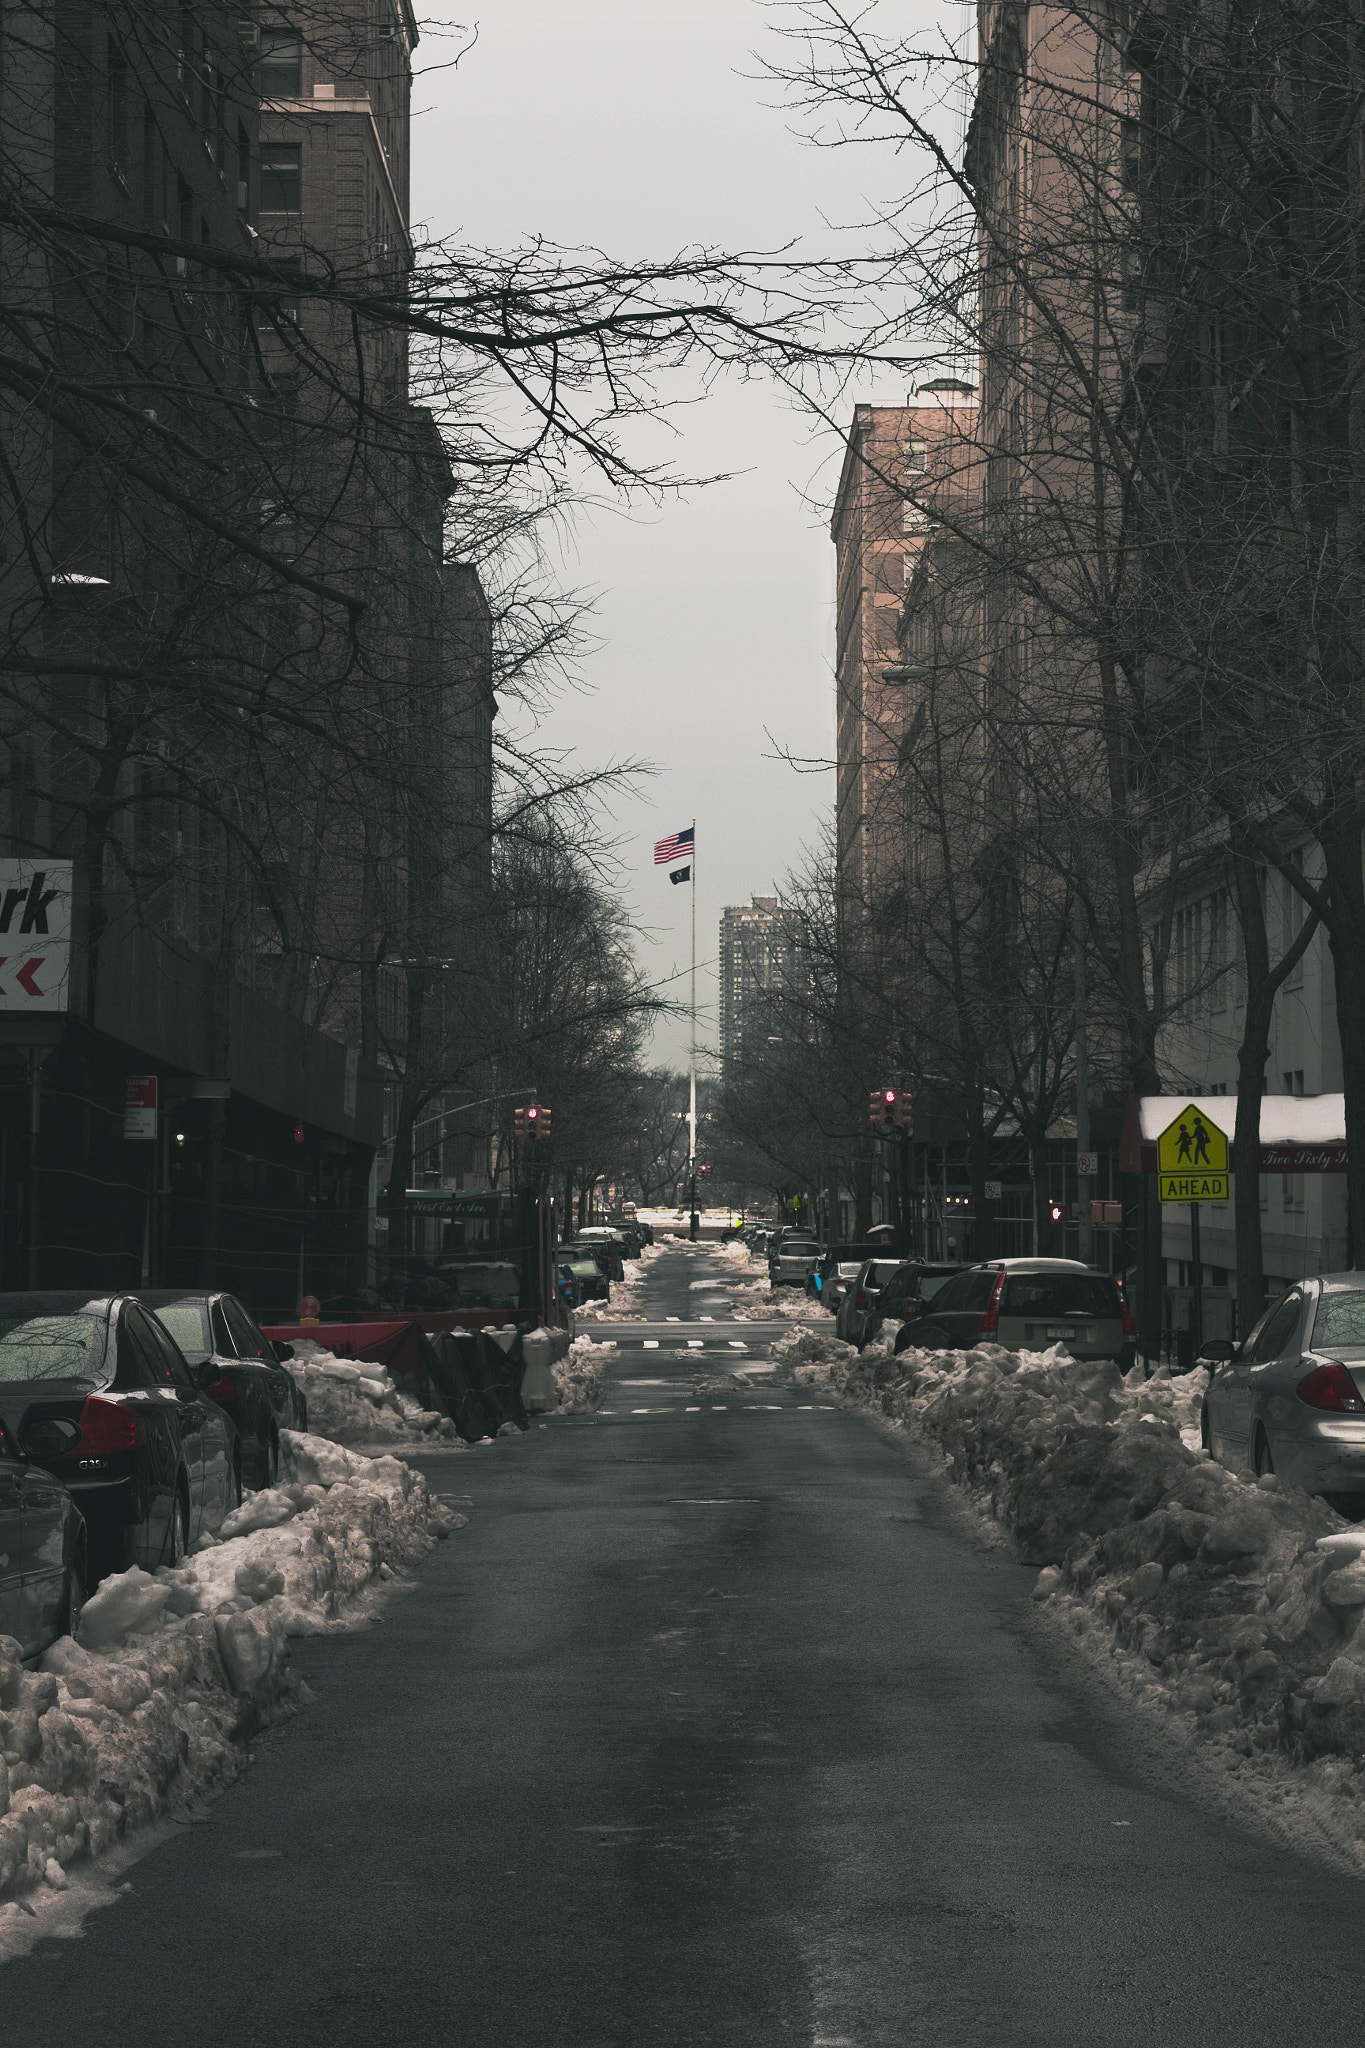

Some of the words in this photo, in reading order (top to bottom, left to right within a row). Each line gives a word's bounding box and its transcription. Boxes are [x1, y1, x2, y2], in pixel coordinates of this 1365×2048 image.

[0, 872, 59, 934] rk
[1262, 1150, 1291, 1165] Two
[1294, 1149, 1332, 1170] Sixty
[1167, 1179, 1222, 1196] AHEAD
